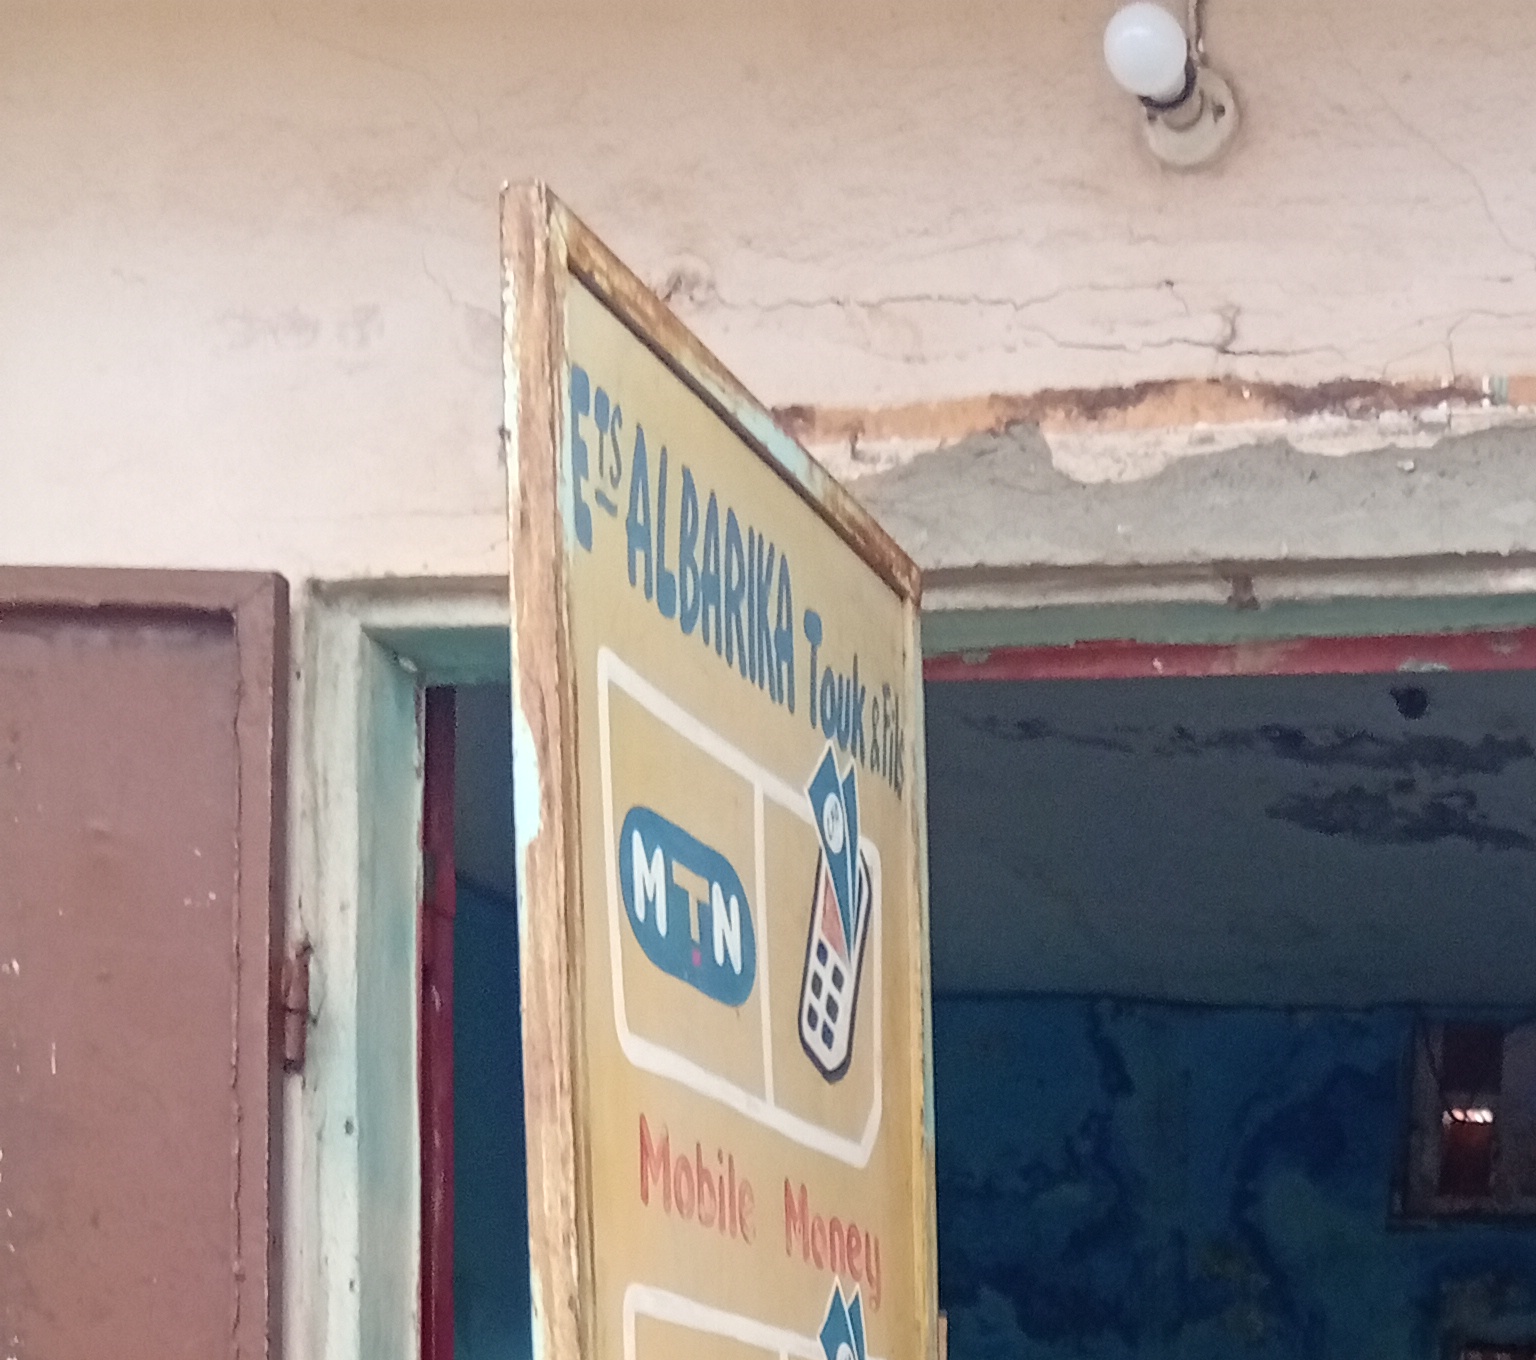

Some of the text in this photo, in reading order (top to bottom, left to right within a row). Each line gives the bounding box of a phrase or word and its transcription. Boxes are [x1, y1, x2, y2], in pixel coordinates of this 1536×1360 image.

[626, 423, 795, 716] ALBARIKA
[803, 607, 867, 773] Touk
[632, 828, 742, 976] MTN
[639, 1112, 882, 1310] Mobile Money
